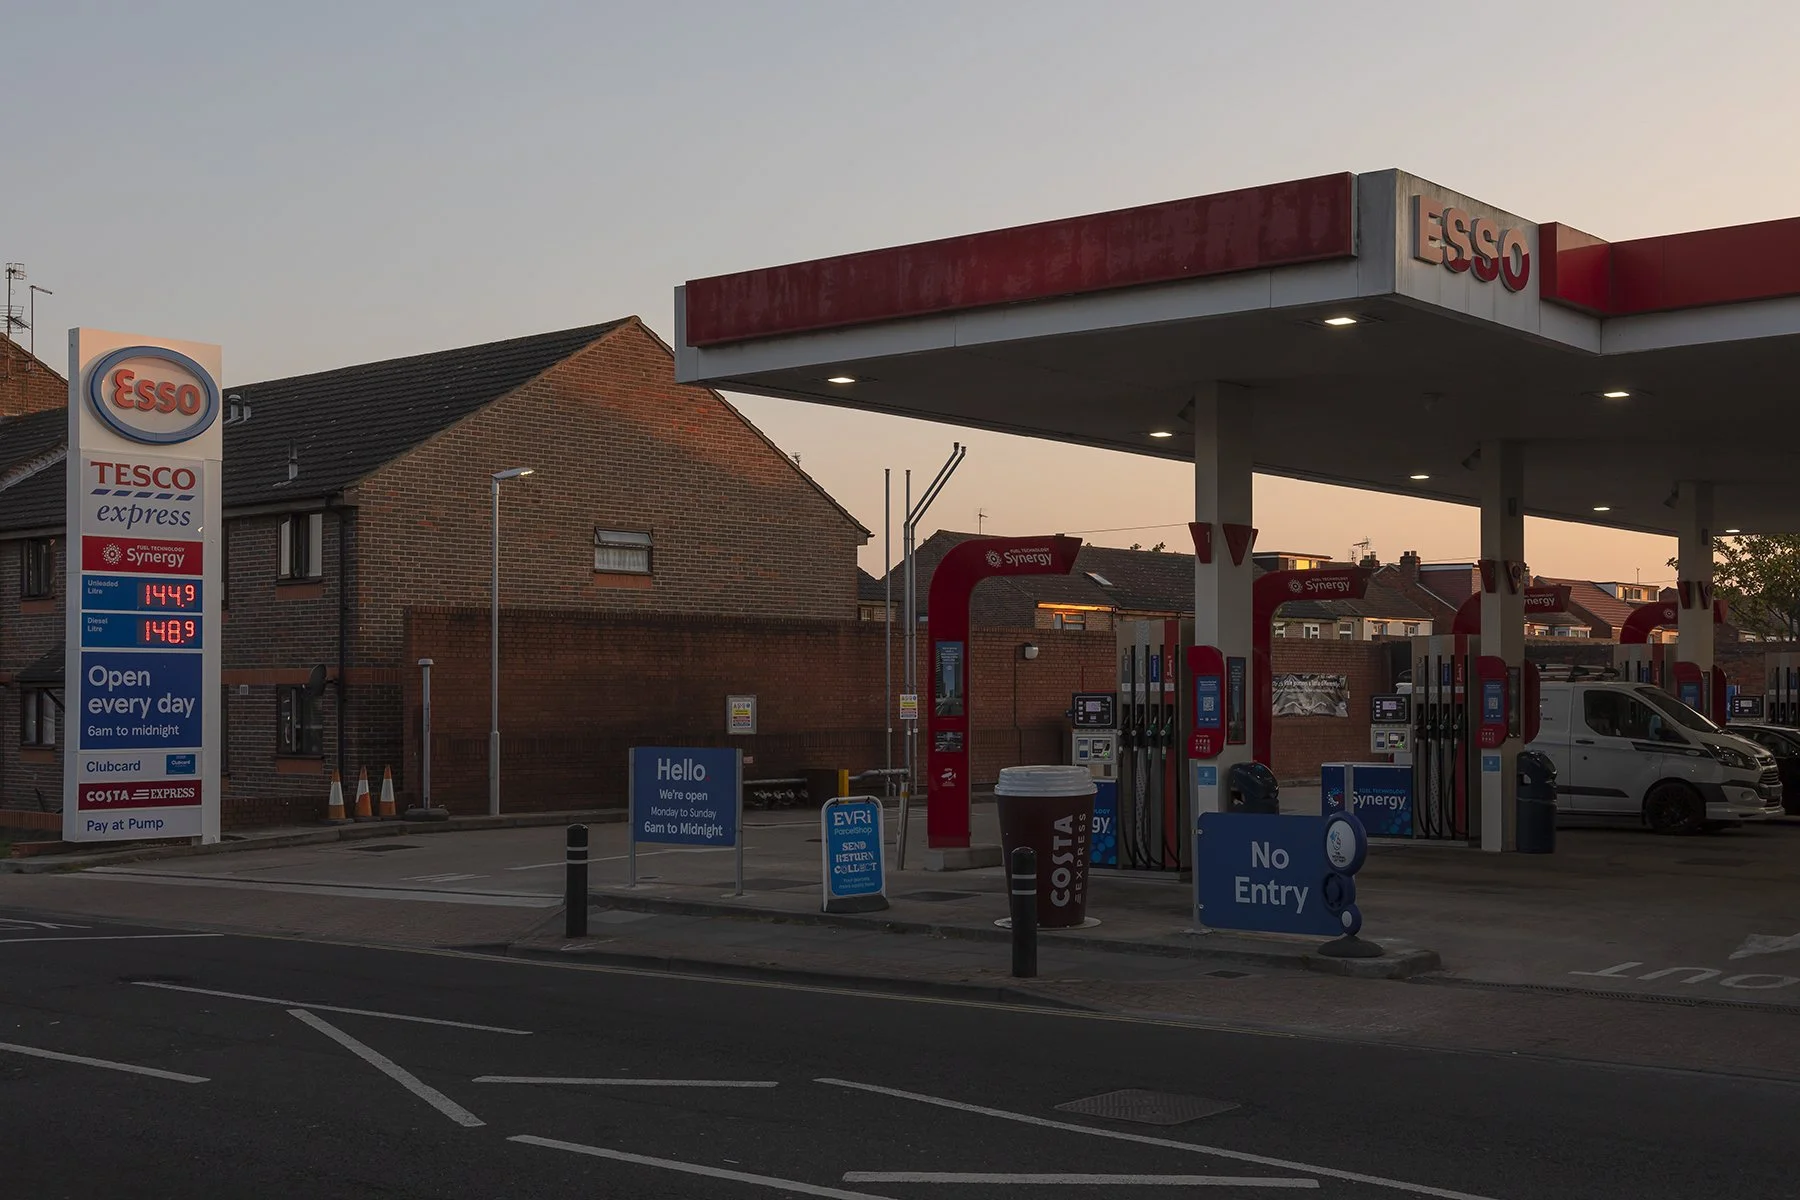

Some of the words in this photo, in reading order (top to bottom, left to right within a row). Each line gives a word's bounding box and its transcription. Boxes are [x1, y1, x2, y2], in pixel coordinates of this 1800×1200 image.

[1413, 195, 1530, 292] ESSO
[113, 368, 200, 416] Esso
[90, 461, 196, 490] TESCO
[97, 504, 191, 529] express
[127, 548, 185, 568] Synergy
[1003, 551, 1052, 567] Synergy
[87, 580, 119, 588] Unleaded
[87, 587, 103, 595] Litre
[1305, 580, 1350, 592] Synergy
[1525, 597, 1555, 607] nergy
[87, 617, 109, 625] Diesel
[87, 625, 103, 633] Litre
[88, 665, 151, 692] Open
[88, 697, 152, 719] every
[157, 693, 196, 719] day
[87, 725, 113, 737] 6am
[116, 726, 129, 736] to
[131, 724, 180, 738] midnight
[86, 760, 141, 773] Clubcard
[86, 789, 130, 802] COSTA
[150, 787, 195, 800] EXPRESS
[659, 788, 683, 800] We're
[685, 791, 708, 803] open
[1353, 791, 1406, 810] Synergy
[650, 806, 678, 819] Monday
[680, 808, 688, 817] to
[689, 807, 717, 819] Sunday
[833, 810, 872, 826] EVRi
[86, 820, 109, 833] Pay
[112, 820, 124, 830] at
[128, 818, 164, 831] Pump
[644, 821, 665, 834] 6am
[667, 822, 678, 834] to
[680, 822, 723, 839] Midnight
[834, 827, 873, 836] ParcelShop
[842, 840, 867, 851] SEND
[1075, 813, 1087, 891] EXPRESS
[836, 851, 874, 863] RETURN
[1050, 814, 1074, 907] COSTA
[1250, 841, 1290, 869] No
[834, 863, 877, 875] COLLECT
[1235, 876, 1309, 914] Entry
